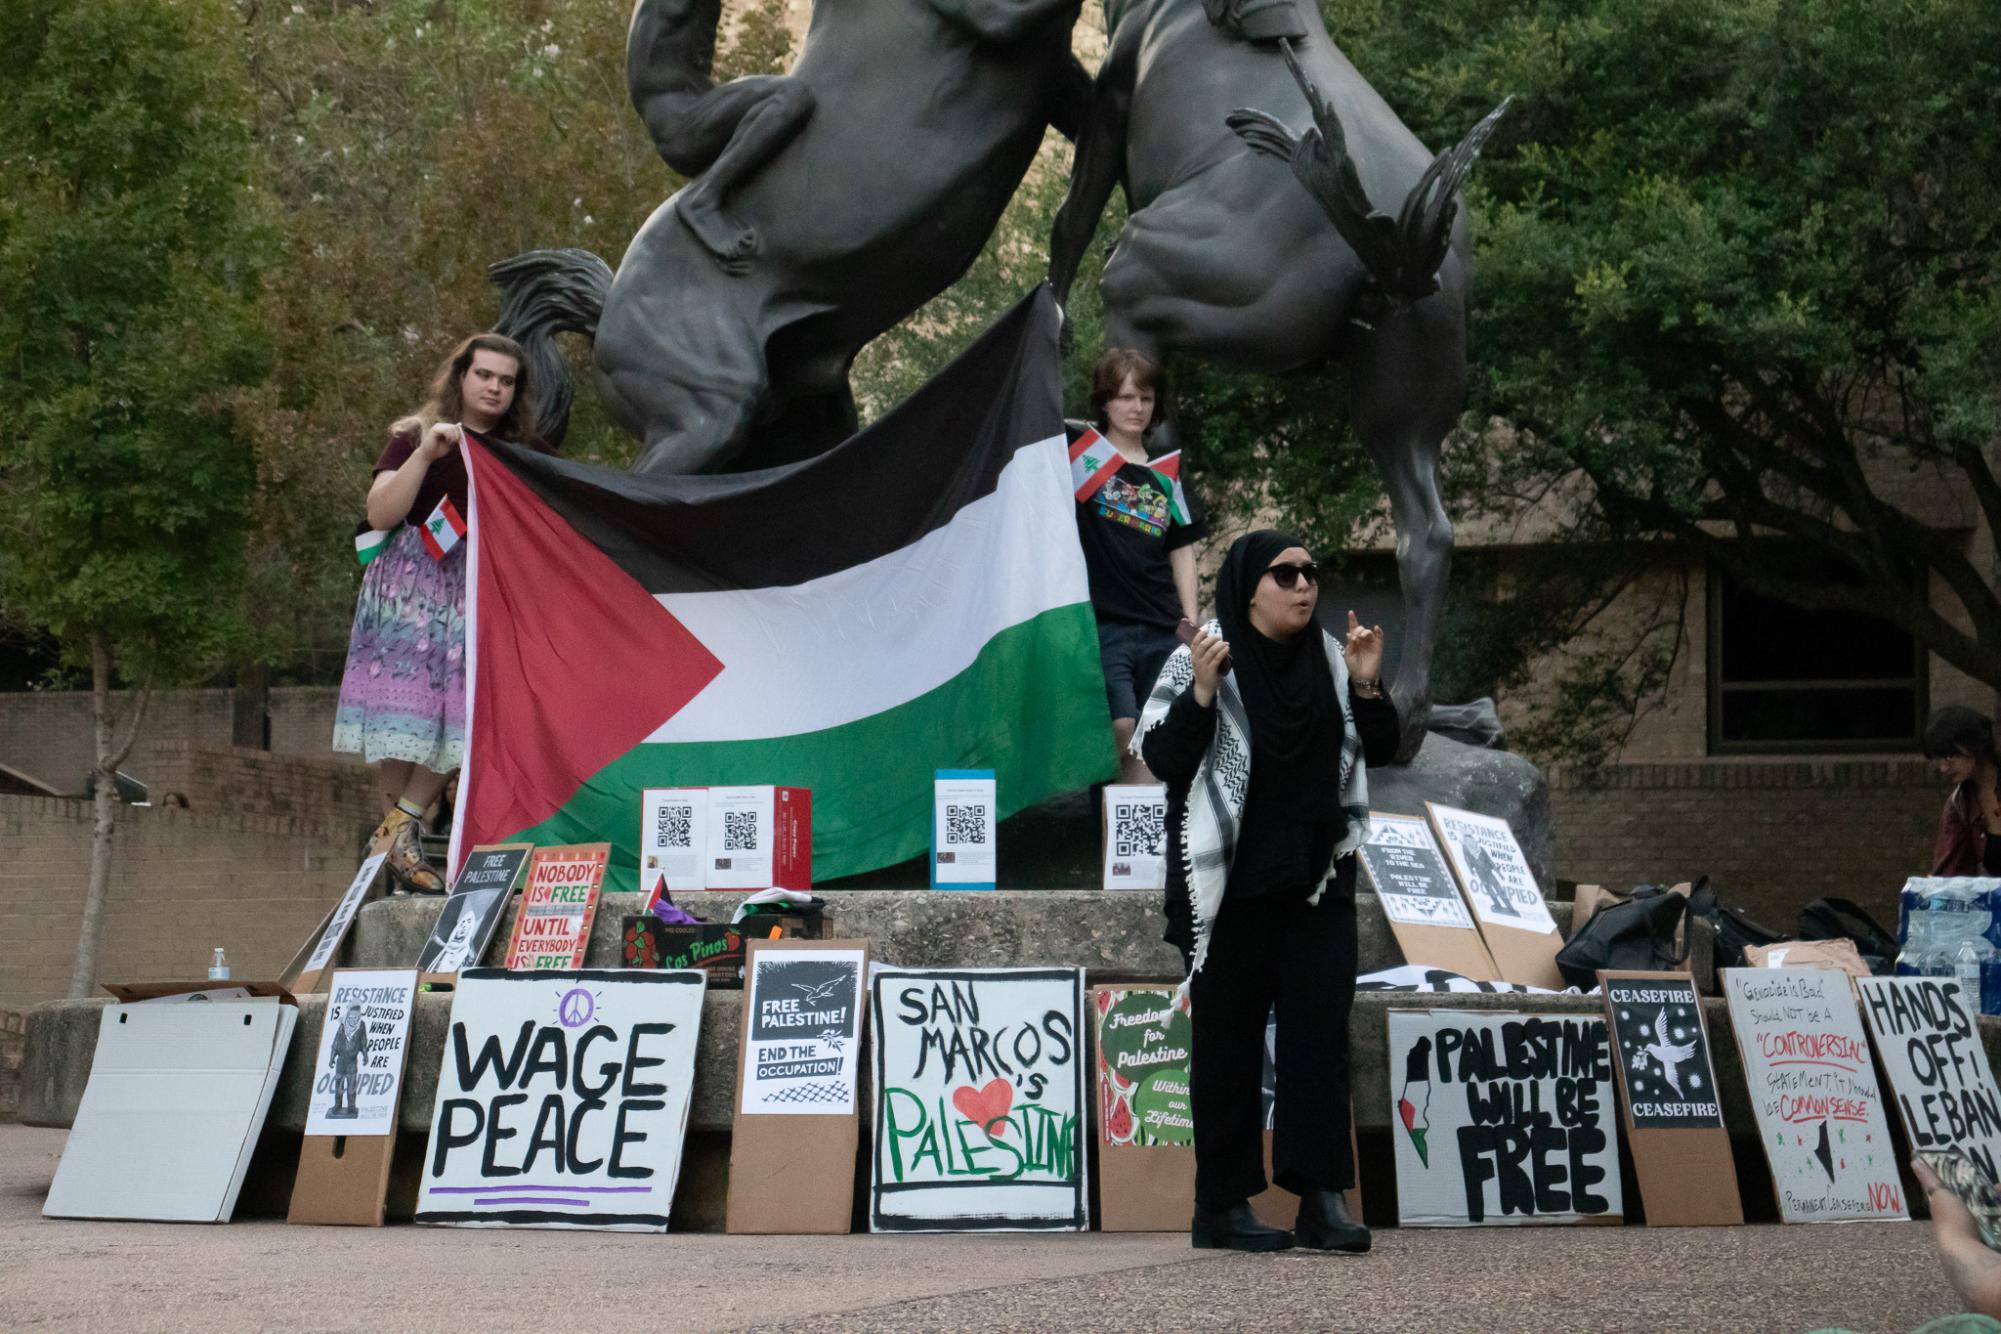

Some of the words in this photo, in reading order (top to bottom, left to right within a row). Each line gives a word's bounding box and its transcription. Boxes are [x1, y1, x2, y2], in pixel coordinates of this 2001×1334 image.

[1443, 817, 1507, 840] RESISTANCE
[483, 854, 506, 867] FREE
[1491, 849, 1513, 862] WHEN
[464, 869, 510, 883] PALESTINE
[536, 863, 595, 883] NOBODY
[1495, 863, 1526, 875] PEOPLE
[1508, 875, 1524, 886] ARE
[530, 886, 544, 902] IS
[551, 885, 588, 903] FREE
[524, 918, 569, 935] UNTIL
[519, 939, 576, 953] EVERYBODY
[689, 938, 728, 961] Pinos
[514, 955, 527, 968] IS
[334, 986, 408, 1004] RESISTANCE
[897, 980, 979, 1026] SAN
[1610, 989, 1694, 1004] CEASEFIRE
[330, 1006, 341, 1021] IS
[362, 1006, 404, 1020] JUSTIFIED
[762, 999, 800, 1014] FREE
[1824, 1007, 1834, 1021] A
[1863, 980, 1971, 1039] HANDS
[761, 1007, 846, 1028] PALESTINE!
[1109, 1008, 1162, 1029] Freedo
[369, 1022, 395, 1035] WHEN
[367, 1037, 401, 1052] PEOPLE
[912, 1010, 1072, 1085] MARCOS
[1143, 1029, 1165, 1048] for
[758, 1047, 787, 1062] END
[789, 1045, 816, 1060] THE
[1117, 1046, 1188, 1068] Palestine
[1435, 1017, 1611, 1083] PALESTINE
[370, 1055, 389, 1068] ARE
[453, 1020, 676, 1099] WAGE
[758, 1057, 844, 1077] OCCUPATION!
[1152, 1080, 1190, 1095] Within
[1168, 1101, 1188, 1111] our
[1466, 1079, 1553, 1128] WILL
[1555, 1077, 1600, 1127] BE
[1632, 1102, 1718, 1117] CEASEFIRE
[1900, 1088, 2001, 1147] LEBAN
[432, 1093, 666, 1179] PEACE
[885, 1087, 1080, 1182] PALESTINE
[1456, 1123, 1610, 1222] FREE
